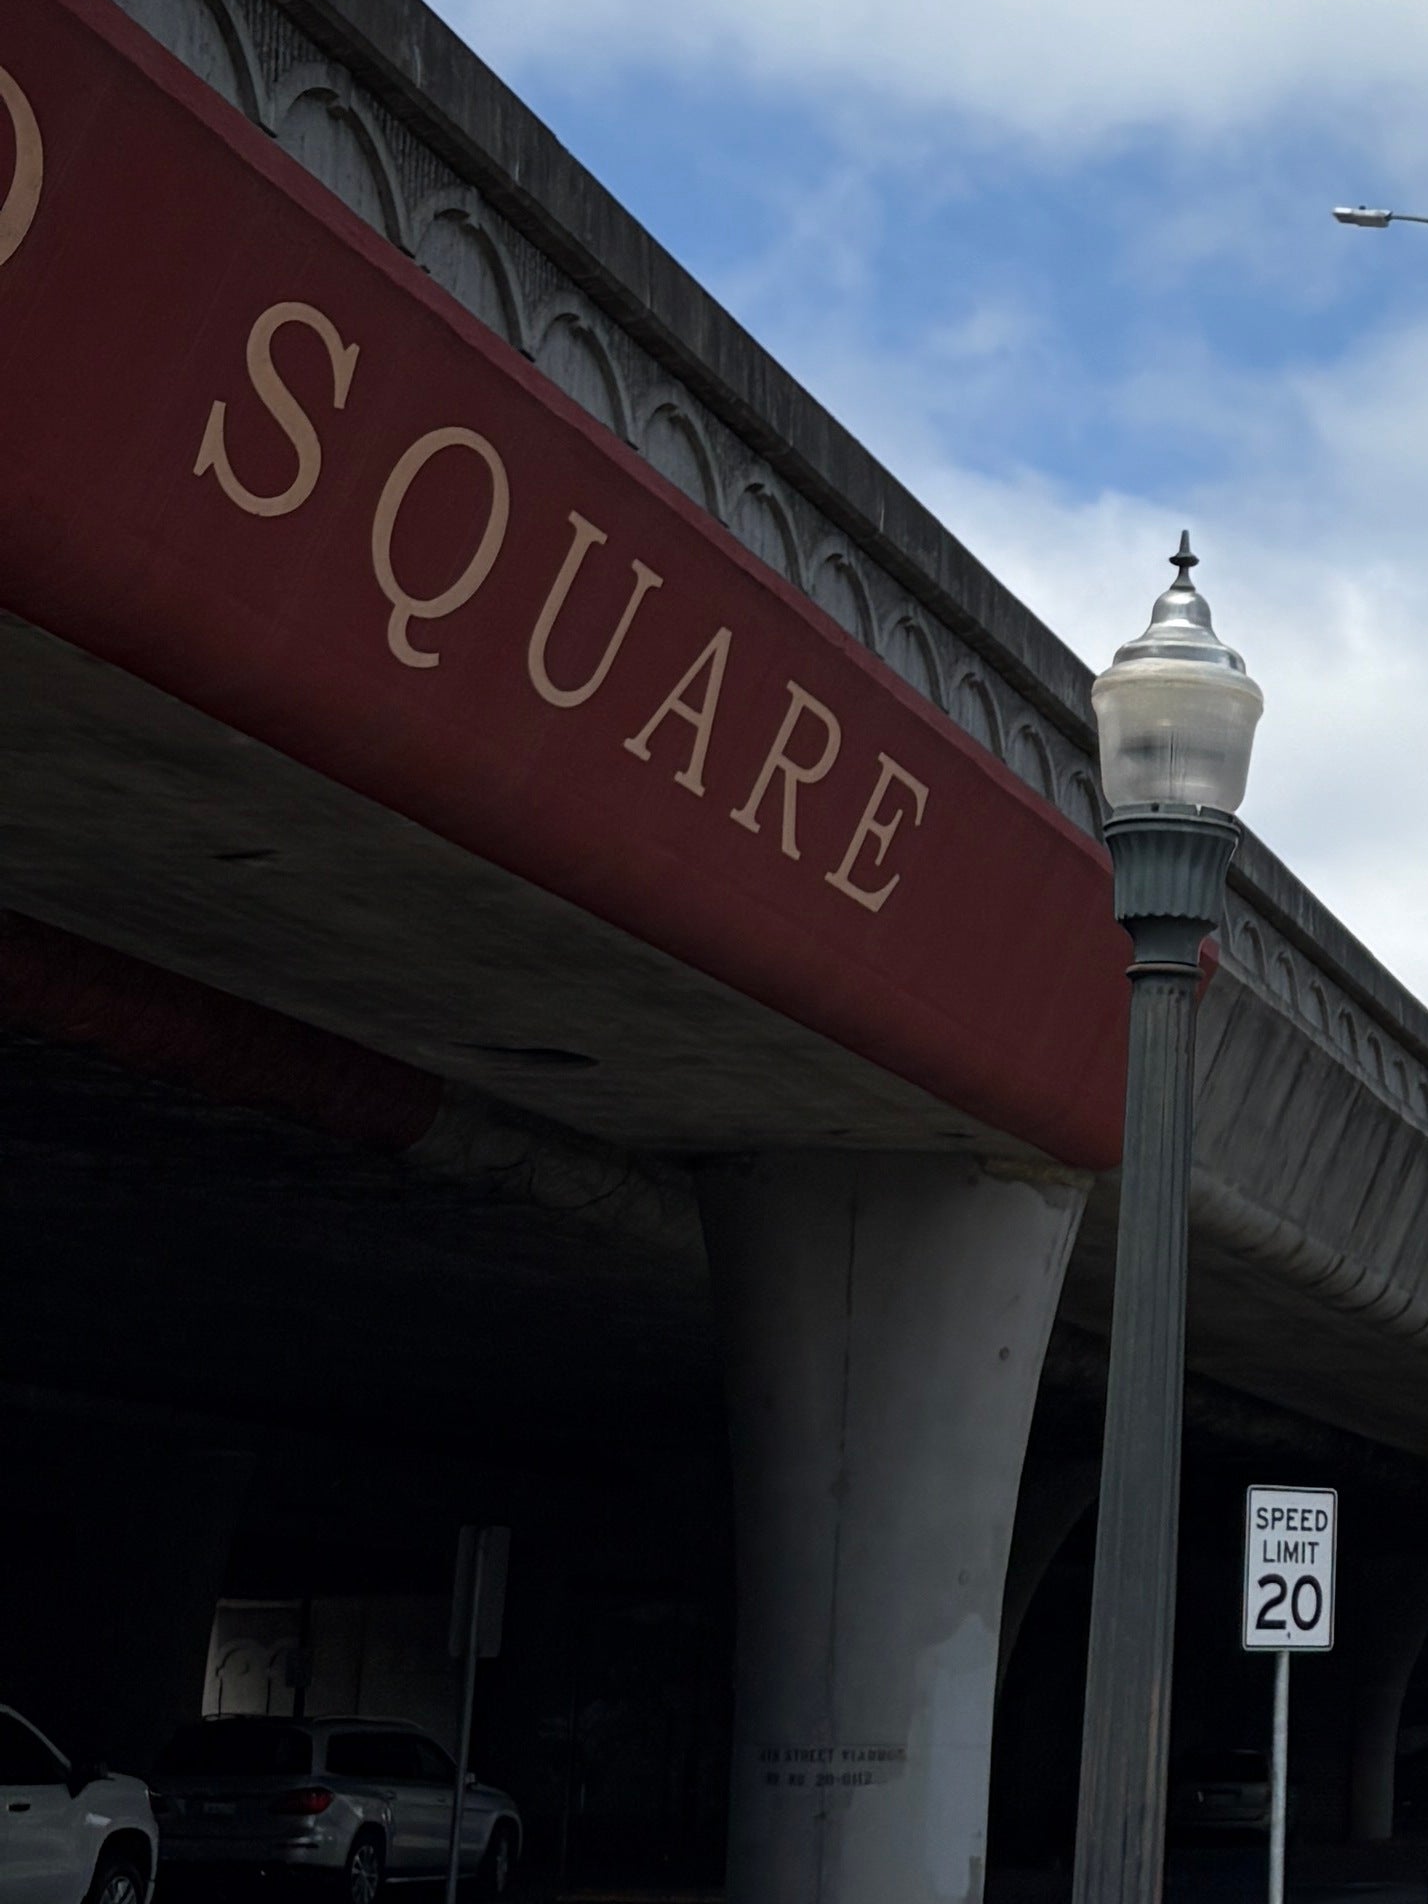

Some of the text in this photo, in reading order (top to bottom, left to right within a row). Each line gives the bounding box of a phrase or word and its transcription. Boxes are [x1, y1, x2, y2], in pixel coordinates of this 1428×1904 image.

[193, 302, 930, 913] SQUARE
[1256, 1506, 1329, 1532] SPEED
[1262, 1540, 1320, 1565] LIMIT
[1255, 1573, 1323, 1631] 20
